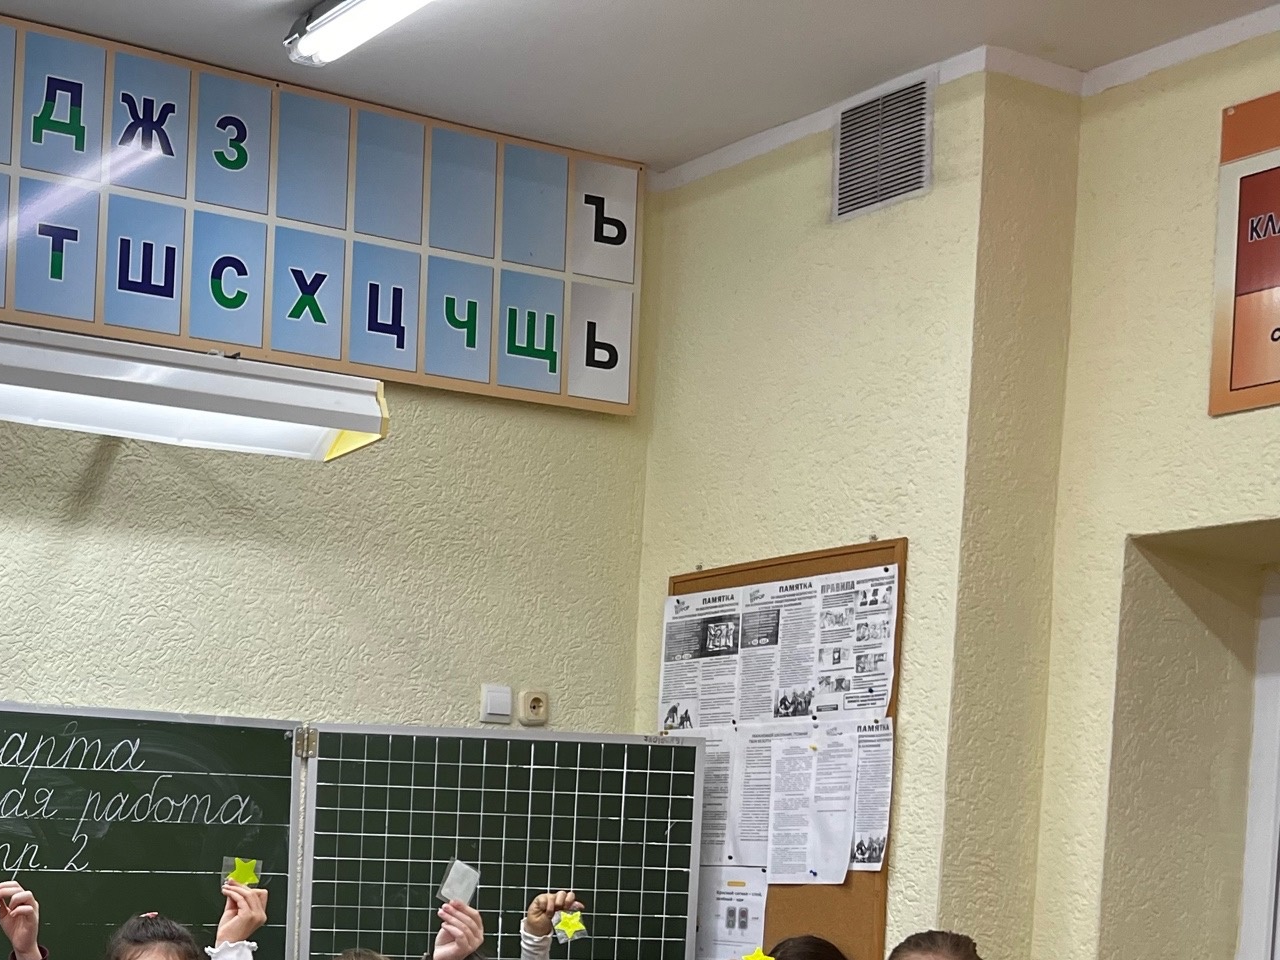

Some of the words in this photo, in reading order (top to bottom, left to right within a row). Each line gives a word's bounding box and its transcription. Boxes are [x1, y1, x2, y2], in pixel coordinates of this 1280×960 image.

[1249, 213, 1280, 242] КЛ
[779, 582, 813, 593] ПАМЯТКА
[702, 594, 735, 605] ПАМЯТКА
[856, 724, 890, 733] ПАМЯТКА
[76, 775, 253, 838] работа
[65, 834, 89, 872] 2
